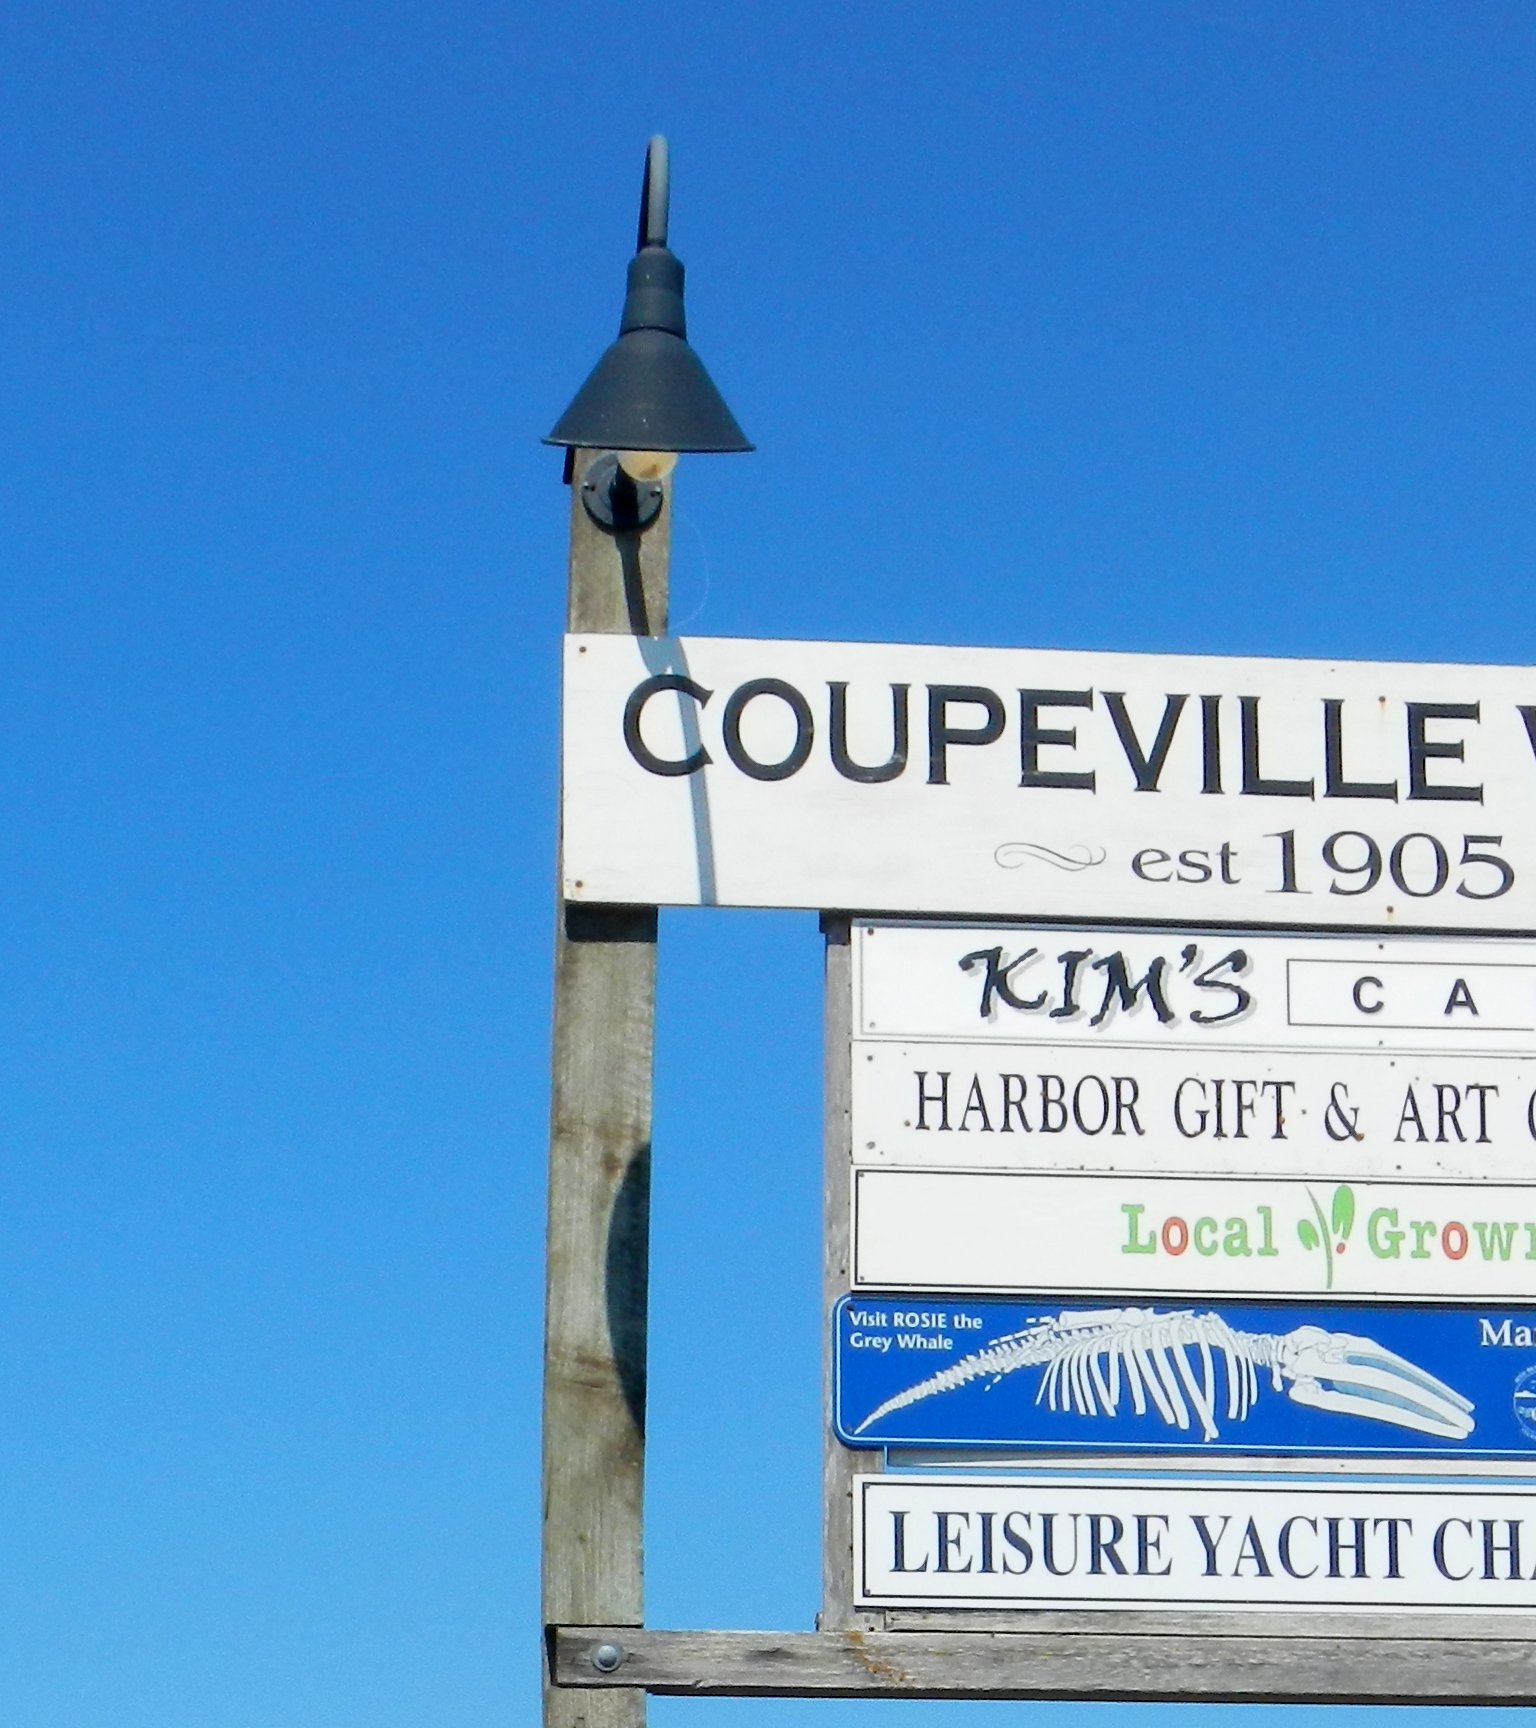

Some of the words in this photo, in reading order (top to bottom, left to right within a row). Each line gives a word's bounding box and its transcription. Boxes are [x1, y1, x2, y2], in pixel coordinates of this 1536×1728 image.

[622, 675, 1485, 805] COUPEVILLE
[1133, 838, 1239, 886] est
[1264, 828, 1516, 900] 1905
[959, 943, 1254, 1028] KIM'S
[914, 1070, 1146, 1136] HARBOR
[1174, 1077, 1296, 1140] GIFT
[1323, 1082, 1363, 1141] &
[1393, 1084, 1499, 1145] ART
[1121, 1203, 1279, 1258] Local
[850, 1311, 888, 1327] Visit
[894, 1312, 948, 1329] ROSIE
[953, 1313, 983, 1329] the
[850, 1332, 893, 1353] Grey
[897, 1333, 953, 1350] Whale
[889, 1510, 1173, 1575] LEISURE
[1192, 1517, 1412, 1580] YACHT
